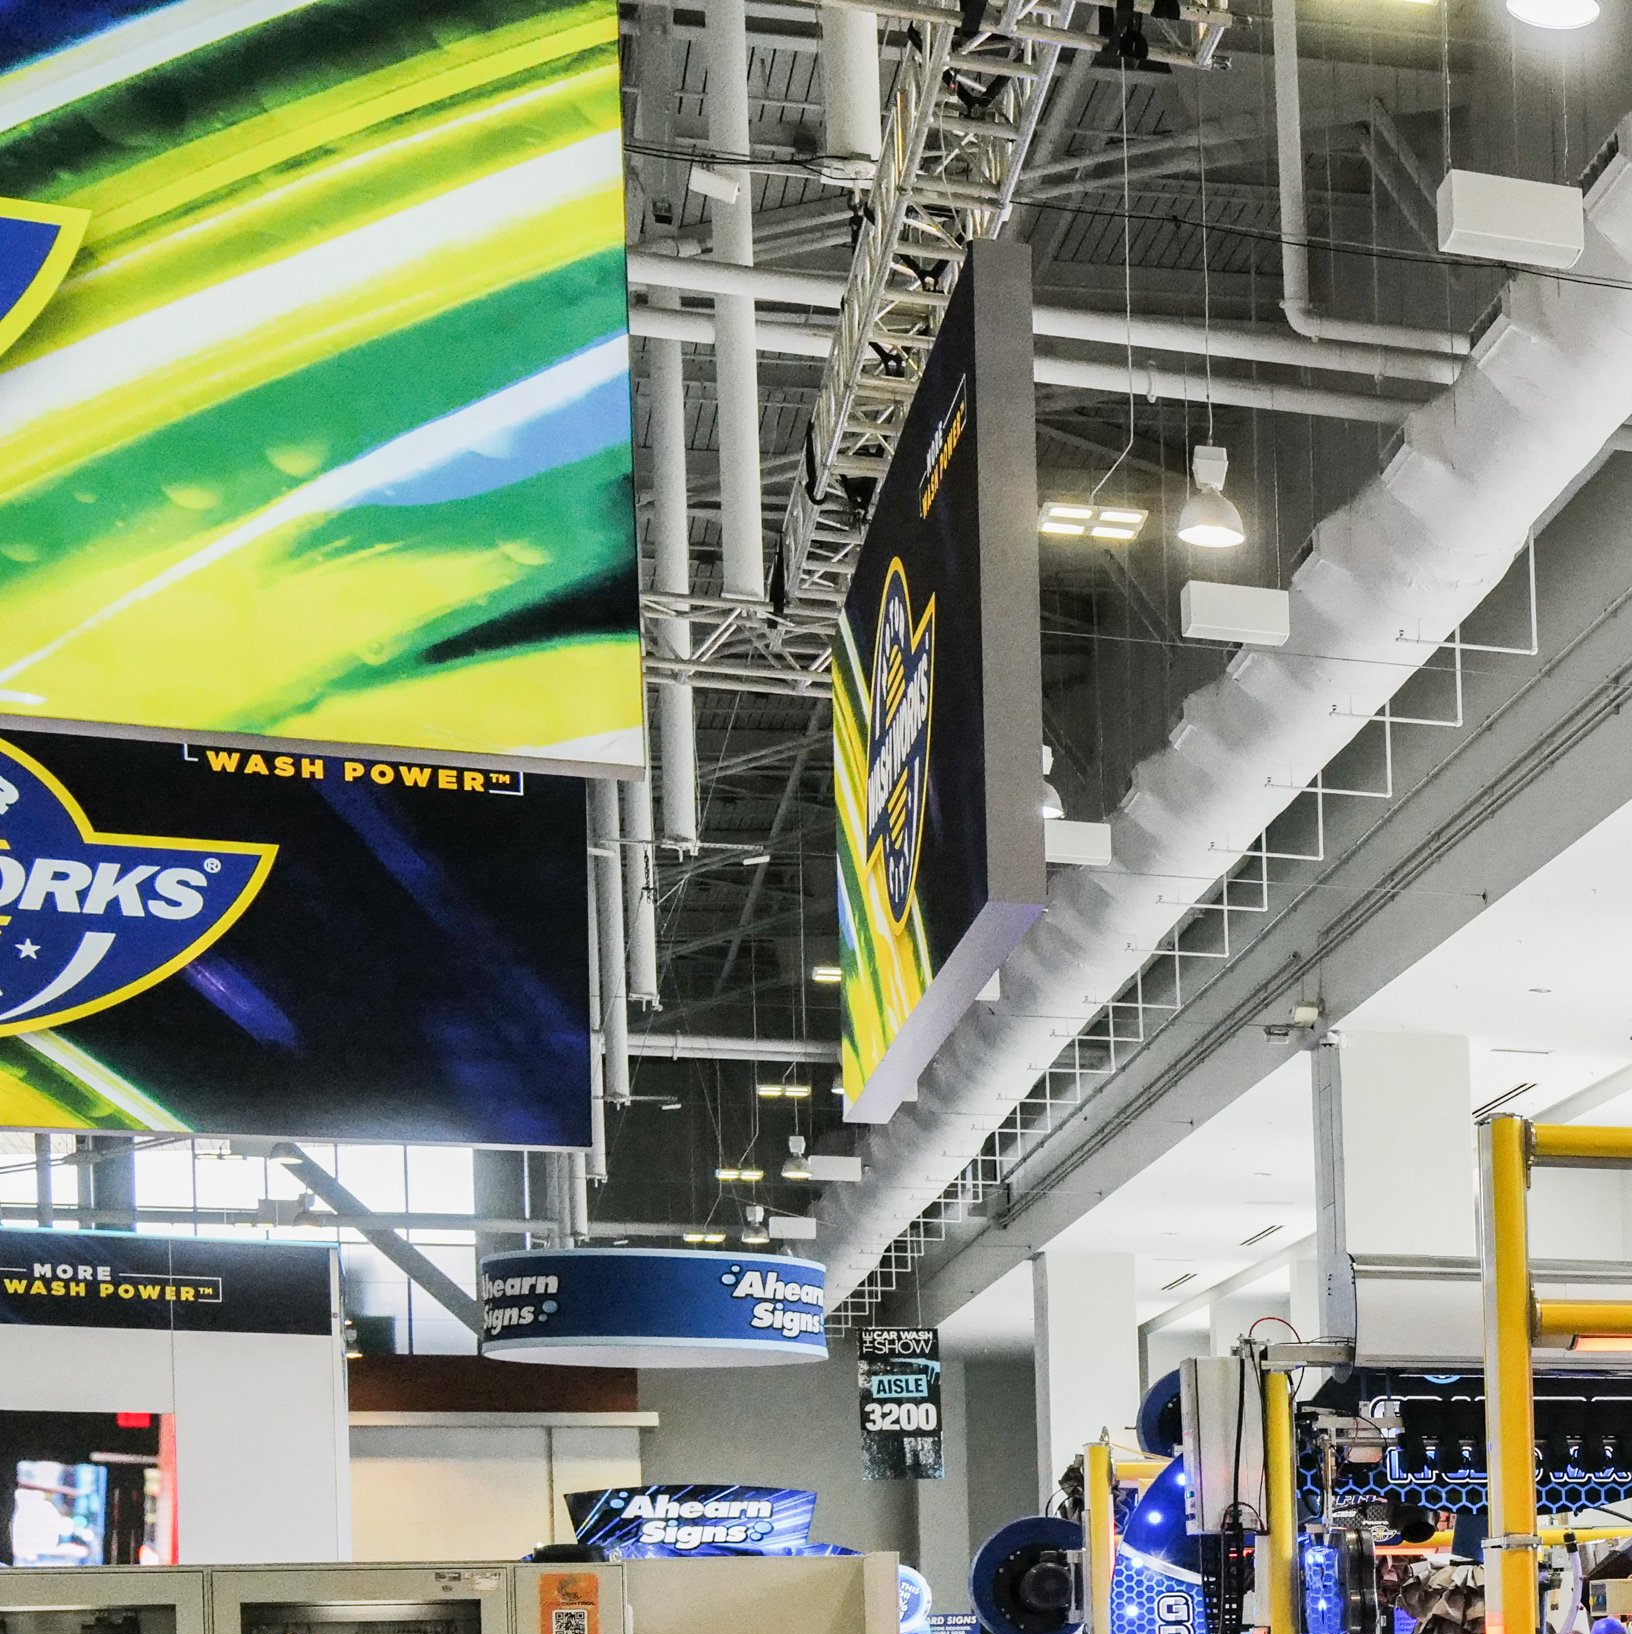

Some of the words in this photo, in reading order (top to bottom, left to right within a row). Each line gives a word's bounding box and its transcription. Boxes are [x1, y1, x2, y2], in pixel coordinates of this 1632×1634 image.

[207, 750, 324, 780] WASH
[868, 729, 893, 836] WASH
[33, 1262, 112, 1282] MORE
[4, 1278, 88, 1299] WASH
[862, 1331, 874, 1354] THE
[873, 1331, 898, 1340] CAR
[899, 1331, 933, 1340] WASH
[874, 1339, 933, 1354] SHOW
[876, 1378, 924, 1395] AISLE
[864, 1402, 938, 1431] 3200
[621, 1495, 773, 1522] Ahearn
[639, 1521, 748, 1550] Signs
[947, 1615, 977, 1625] SIGNS
